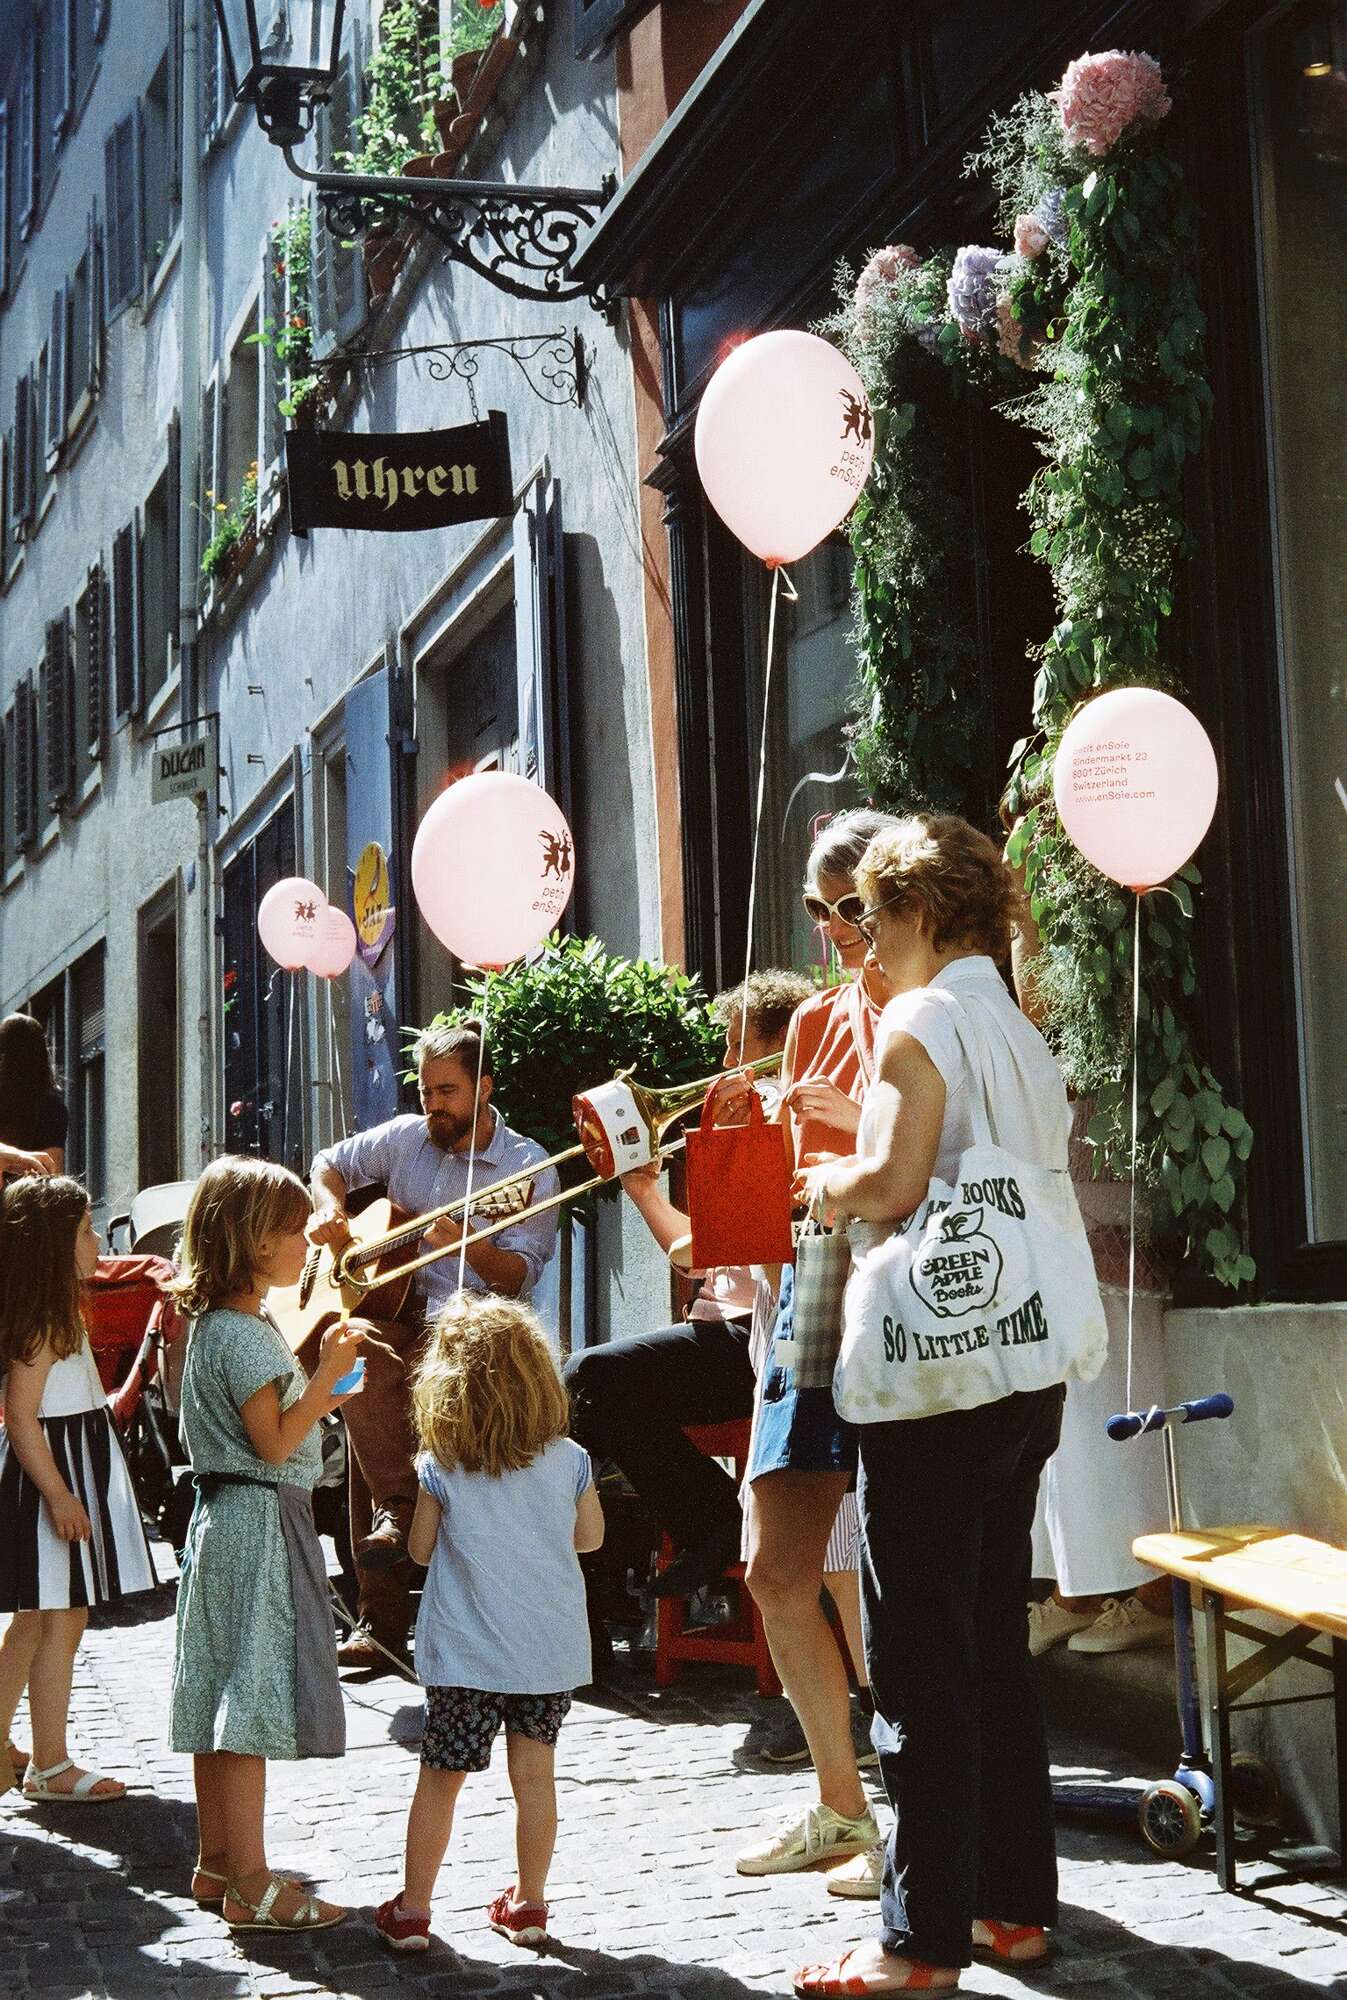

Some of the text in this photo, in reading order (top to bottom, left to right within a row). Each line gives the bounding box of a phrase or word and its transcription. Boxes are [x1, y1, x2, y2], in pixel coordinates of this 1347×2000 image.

[330, 456, 480, 512] Uhren
[1096, 740, 1130, 751] enSoie
[161, 742, 206, 778] DUCAN
[1073, 752, 1148, 766] Rindermarkt 23
[1072, 766, 1127, 779] 8001 Zürich
[1073, 779, 1128, 791] Switzerland
[361, 903, 384, 928] JAZ
[920, 1248, 990, 1276] GREEN
[931, 1266, 984, 1289] APPLE
[932, 1281, 985, 1303] Books
[883, 1290, 1049, 1363] SO LITTLE TIME
